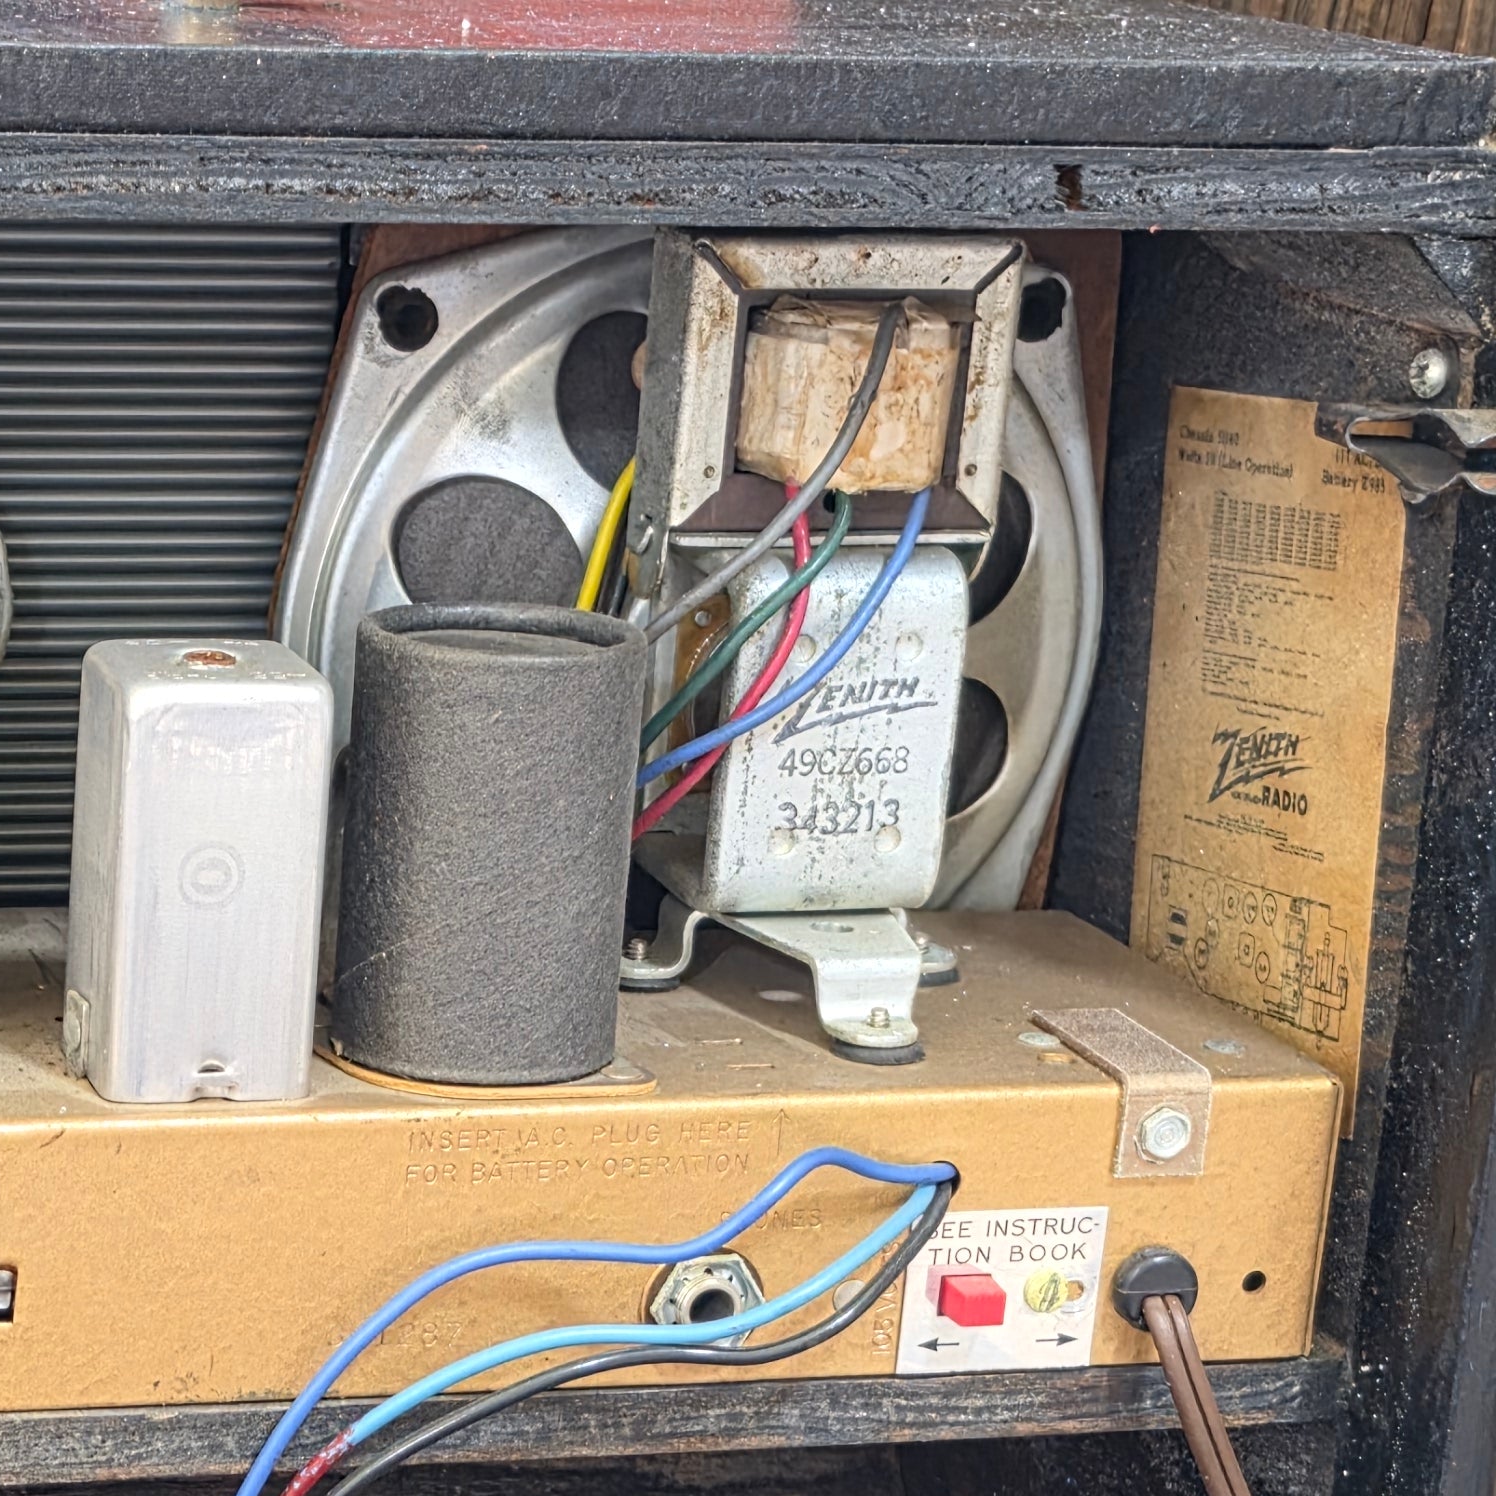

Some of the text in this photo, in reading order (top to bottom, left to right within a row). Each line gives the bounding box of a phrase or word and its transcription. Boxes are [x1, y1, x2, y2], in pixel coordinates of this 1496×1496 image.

[771, 676, 938, 744] ZENITH
[778, 746, 910, 777] 49CZ668
[1207, 721, 1313, 804] ZENITH
[1261, 785, 1308, 816] RADIO
[408, 1128, 507, 1153] INSERT
[591, 1122, 661, 1146] PLUG
[678, 1120, 752, 1143] HERE
[406, 1153, 749, 1187] FOR BATTERY OPERATION
[986, 1216, 1100, 1238] INSTRUC-
[928, 1242, 1087, 1266] TION BOOK
